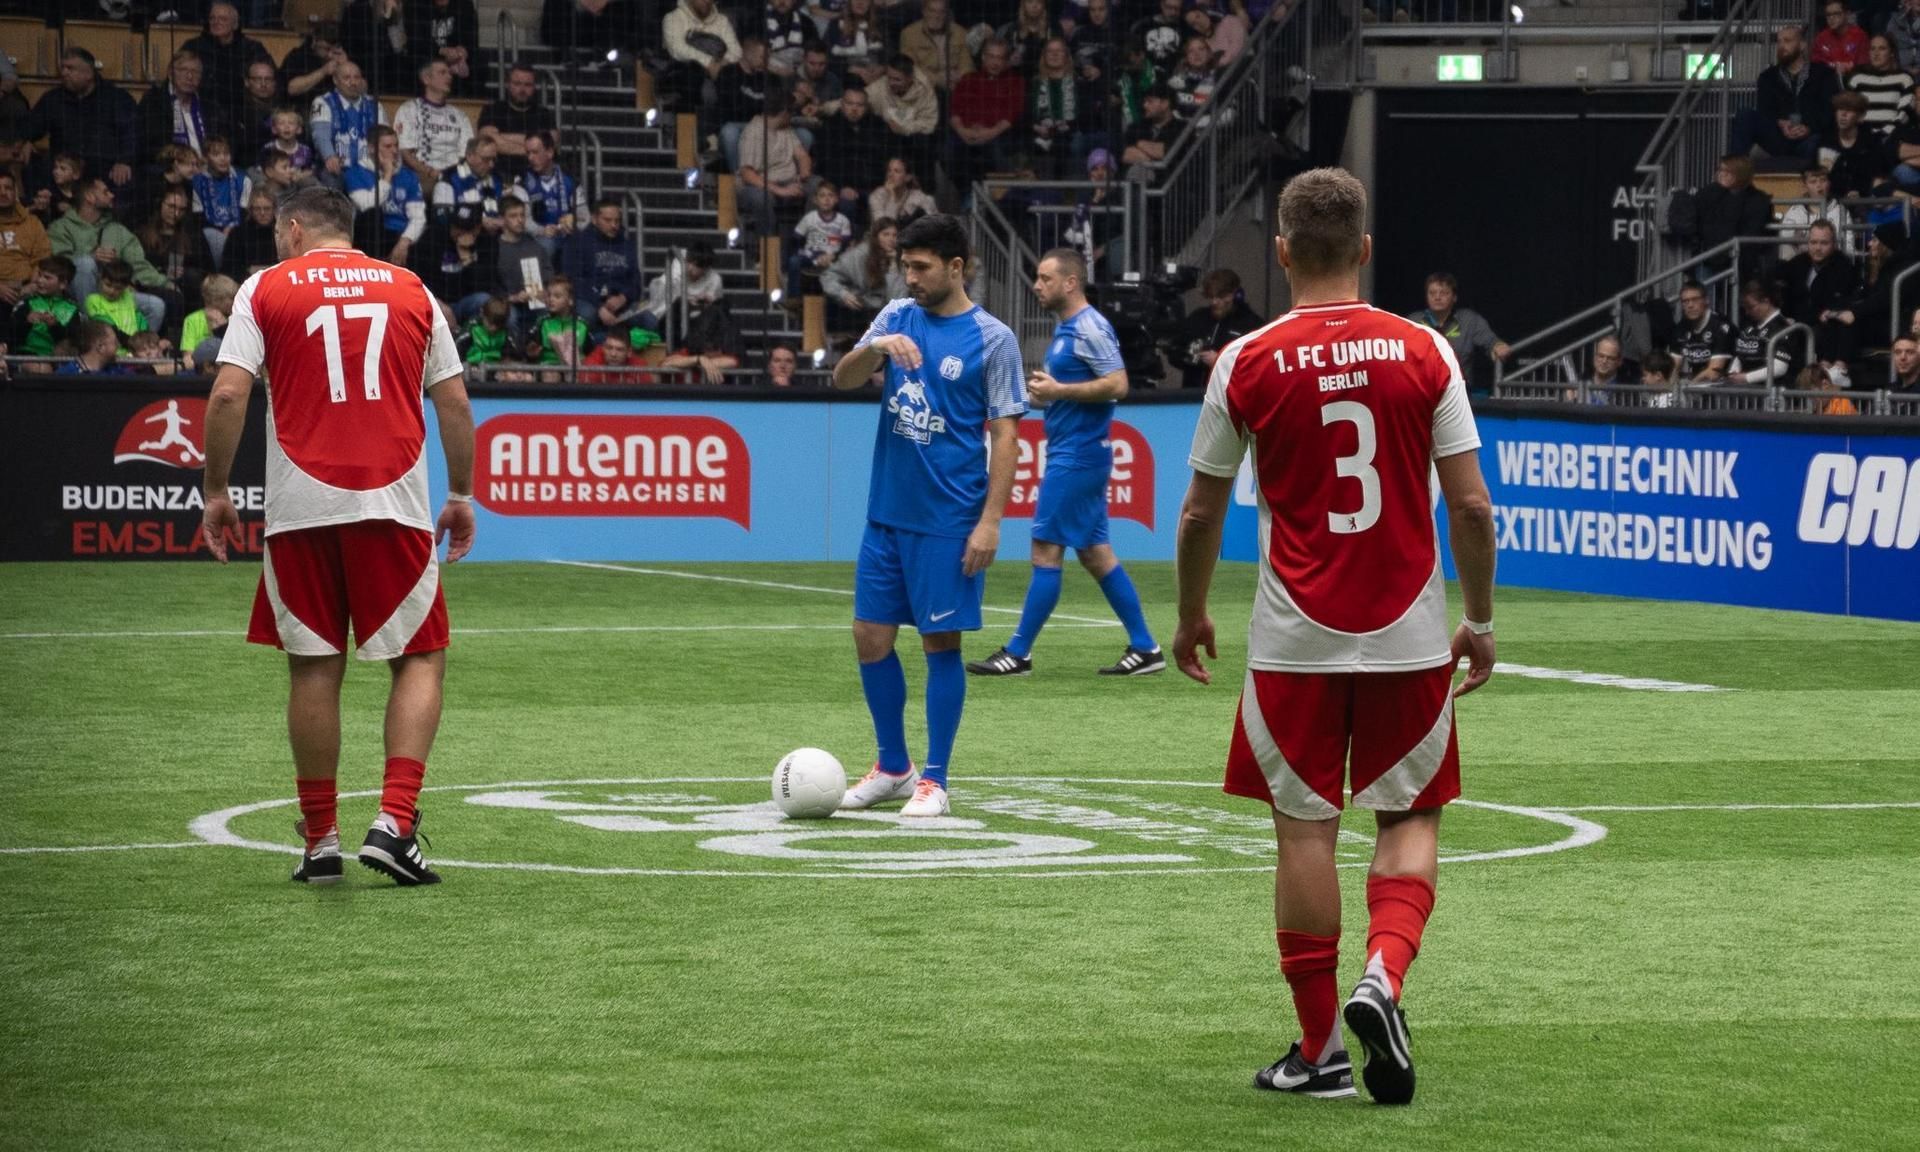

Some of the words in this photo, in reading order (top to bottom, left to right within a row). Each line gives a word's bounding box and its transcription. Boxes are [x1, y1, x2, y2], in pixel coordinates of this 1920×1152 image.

[288, 271, 304, 285] 1.
[307, 268, 330, 283] FC
[334, 268, 394, 283] UNION
[323, 286, 364, 298] BERLIN
[305, 303, 389, 403] 17
[1273, 349, 1294, 374] 1.
[1297, 344, 1327, 369] FC
[1331, 338, 1406, 366] UNION
[1318, 370, 1369, 392] BERLIN
[887, 396, 946, 433] seda
[1321, 400, 1382, 534] 3
[1497, 440, 1740, 499] WERBETECHNIK
[62, 485, 265, 510] BUDENZABE
[490, 482, 727, 502] NIEDERSACHSEN
[1491, 505, 1773, 571] EXTILVEREDELUNG
